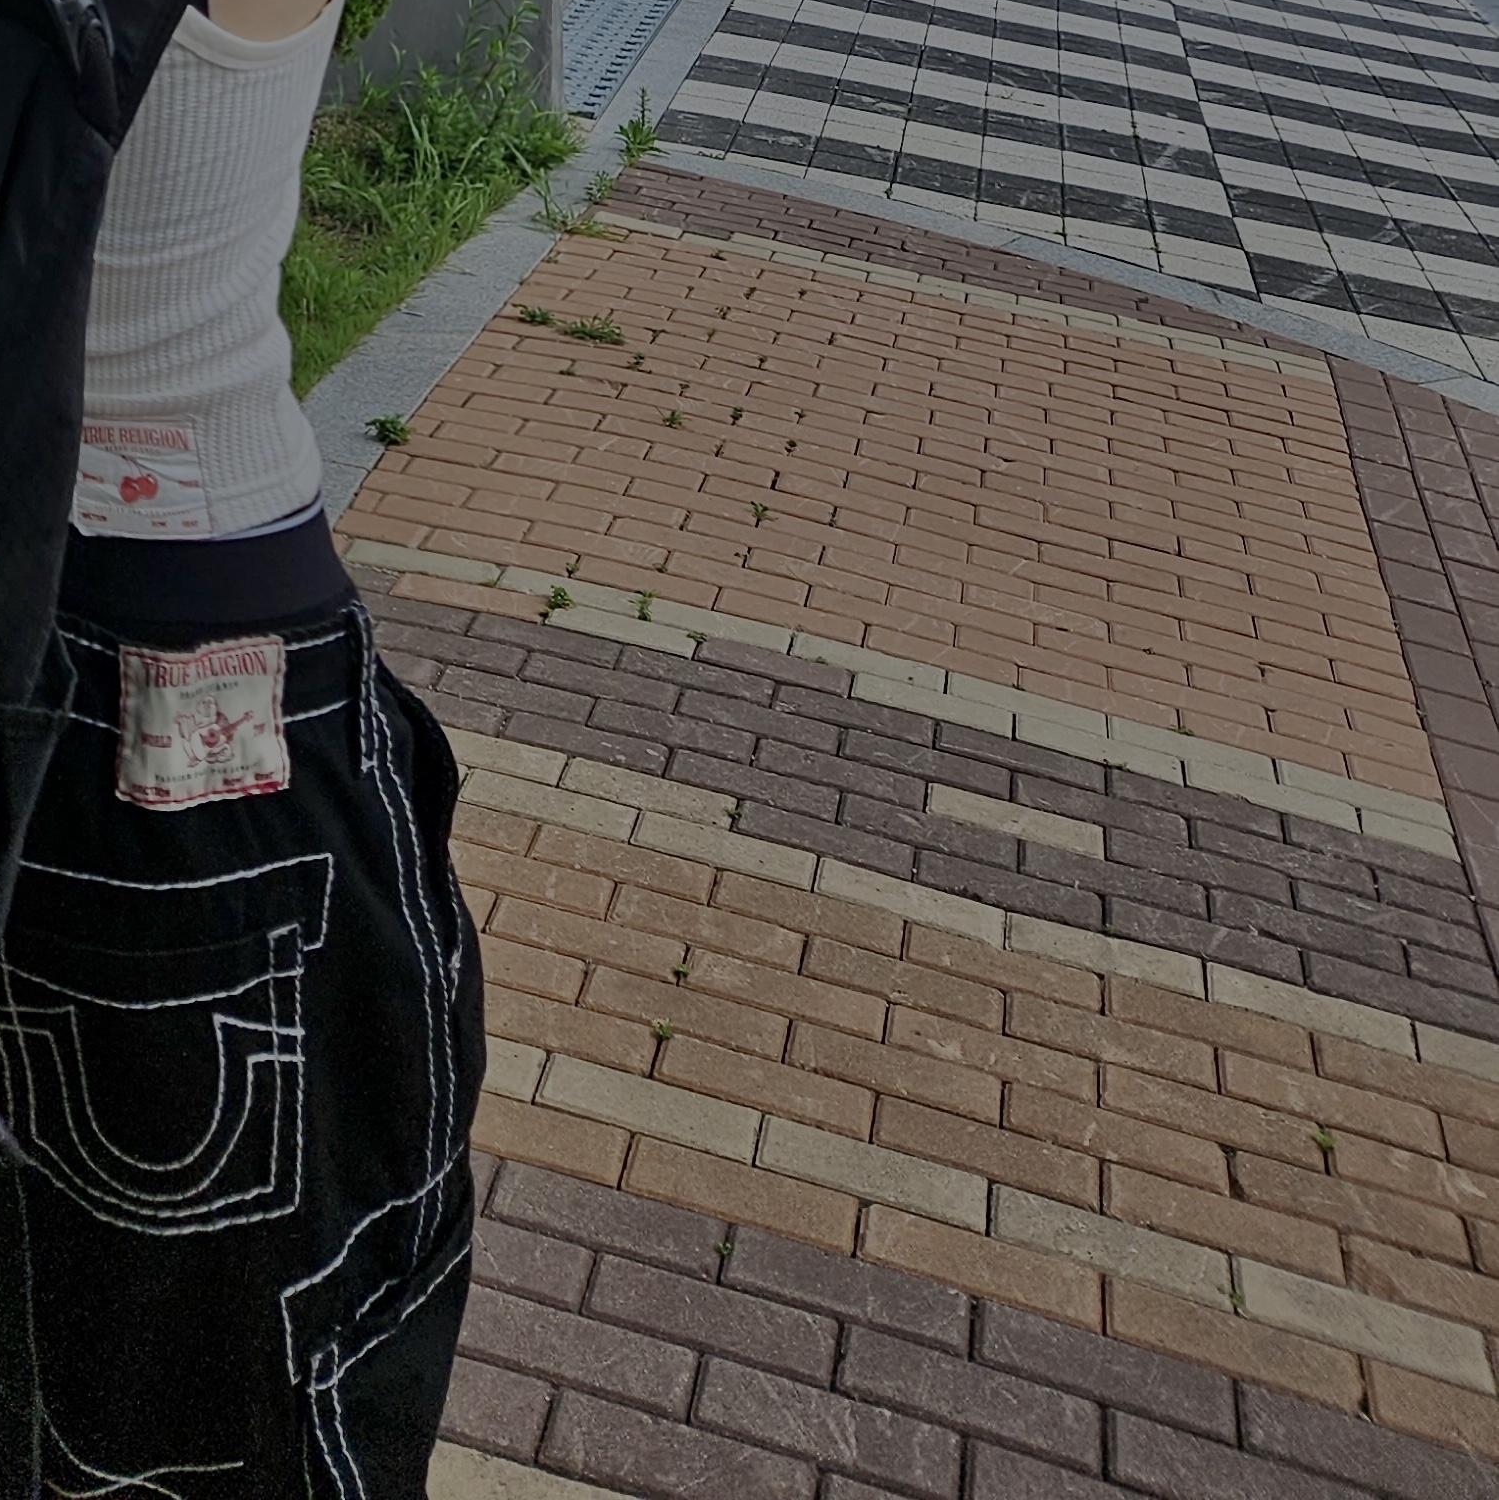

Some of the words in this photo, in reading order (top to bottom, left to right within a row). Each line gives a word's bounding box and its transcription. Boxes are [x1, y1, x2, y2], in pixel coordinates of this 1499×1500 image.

[83, 426, 115, 445] TRUE
[119, 428, 190, 452] RELIGION
[142, 661, 190, 688] TRUE
